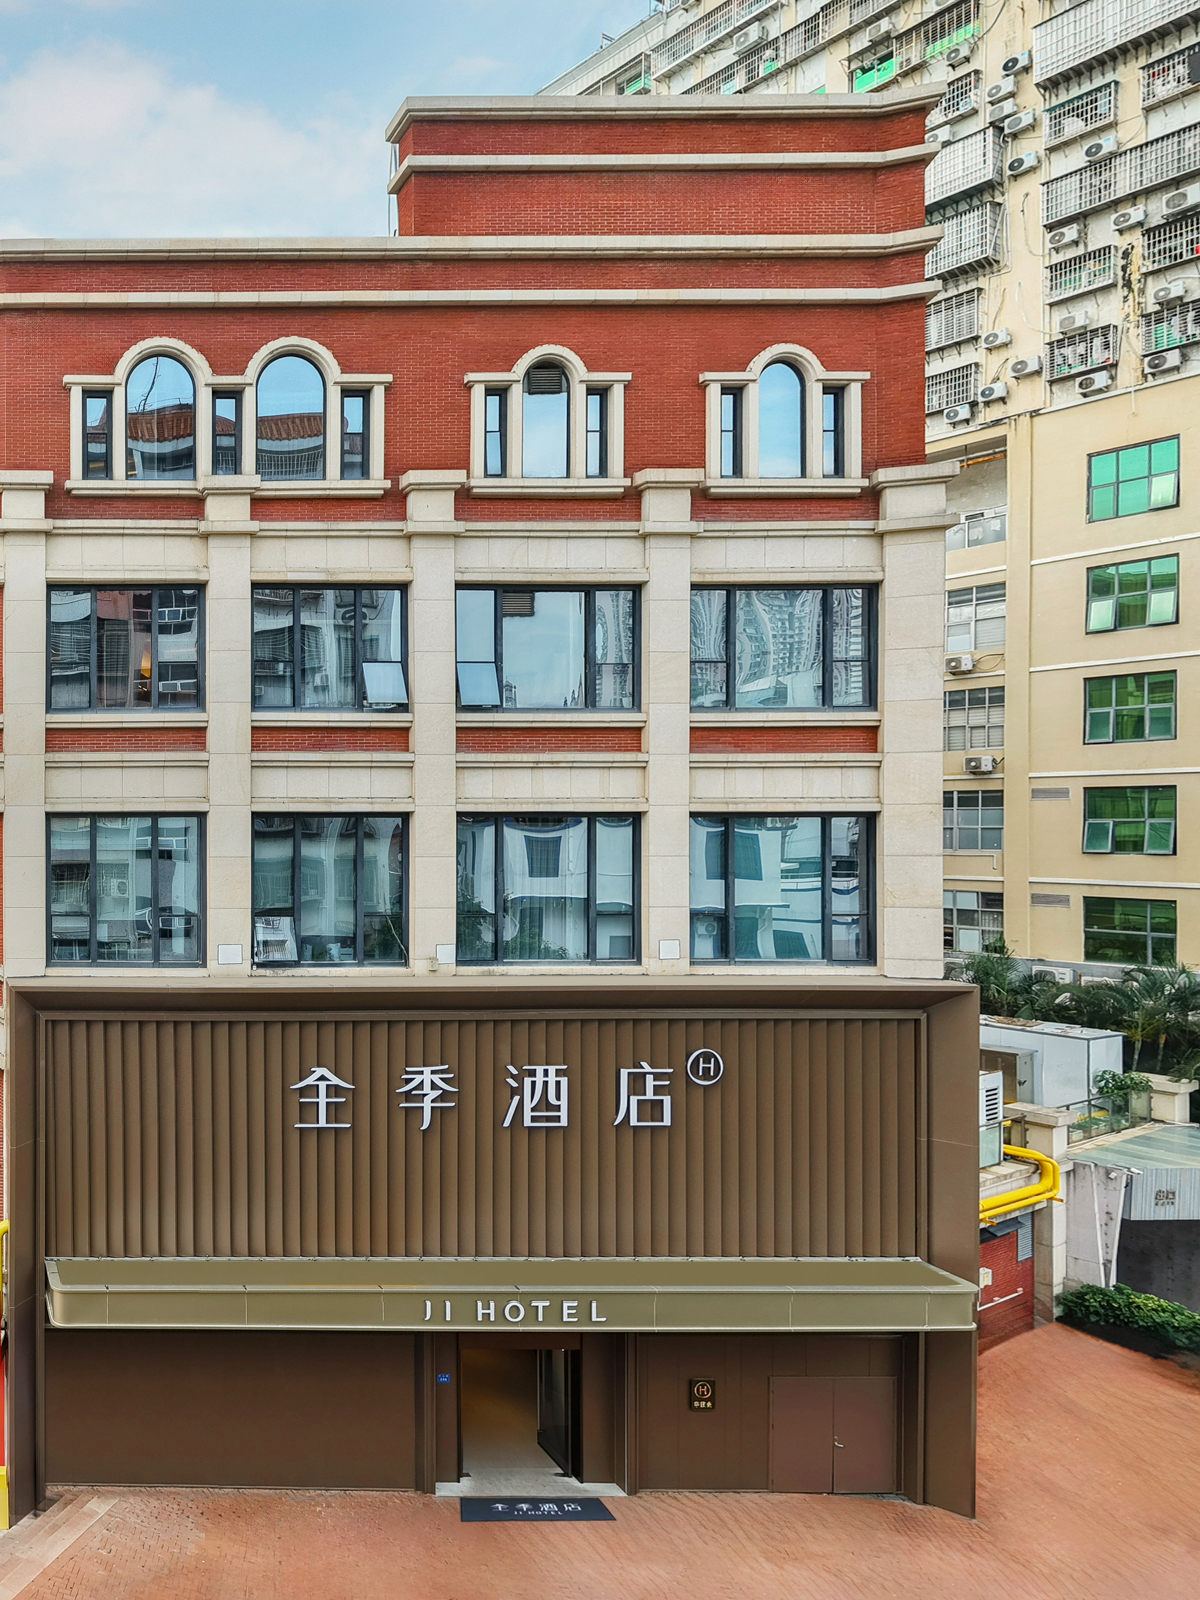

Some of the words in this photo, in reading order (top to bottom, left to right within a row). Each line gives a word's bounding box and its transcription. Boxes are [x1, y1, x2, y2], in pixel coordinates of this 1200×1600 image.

[290, 1061, 674, 1130] 全季酒店
[424, 1300, 451, 1321] JI
[476, 1300, 607, 1322] HOTEL
